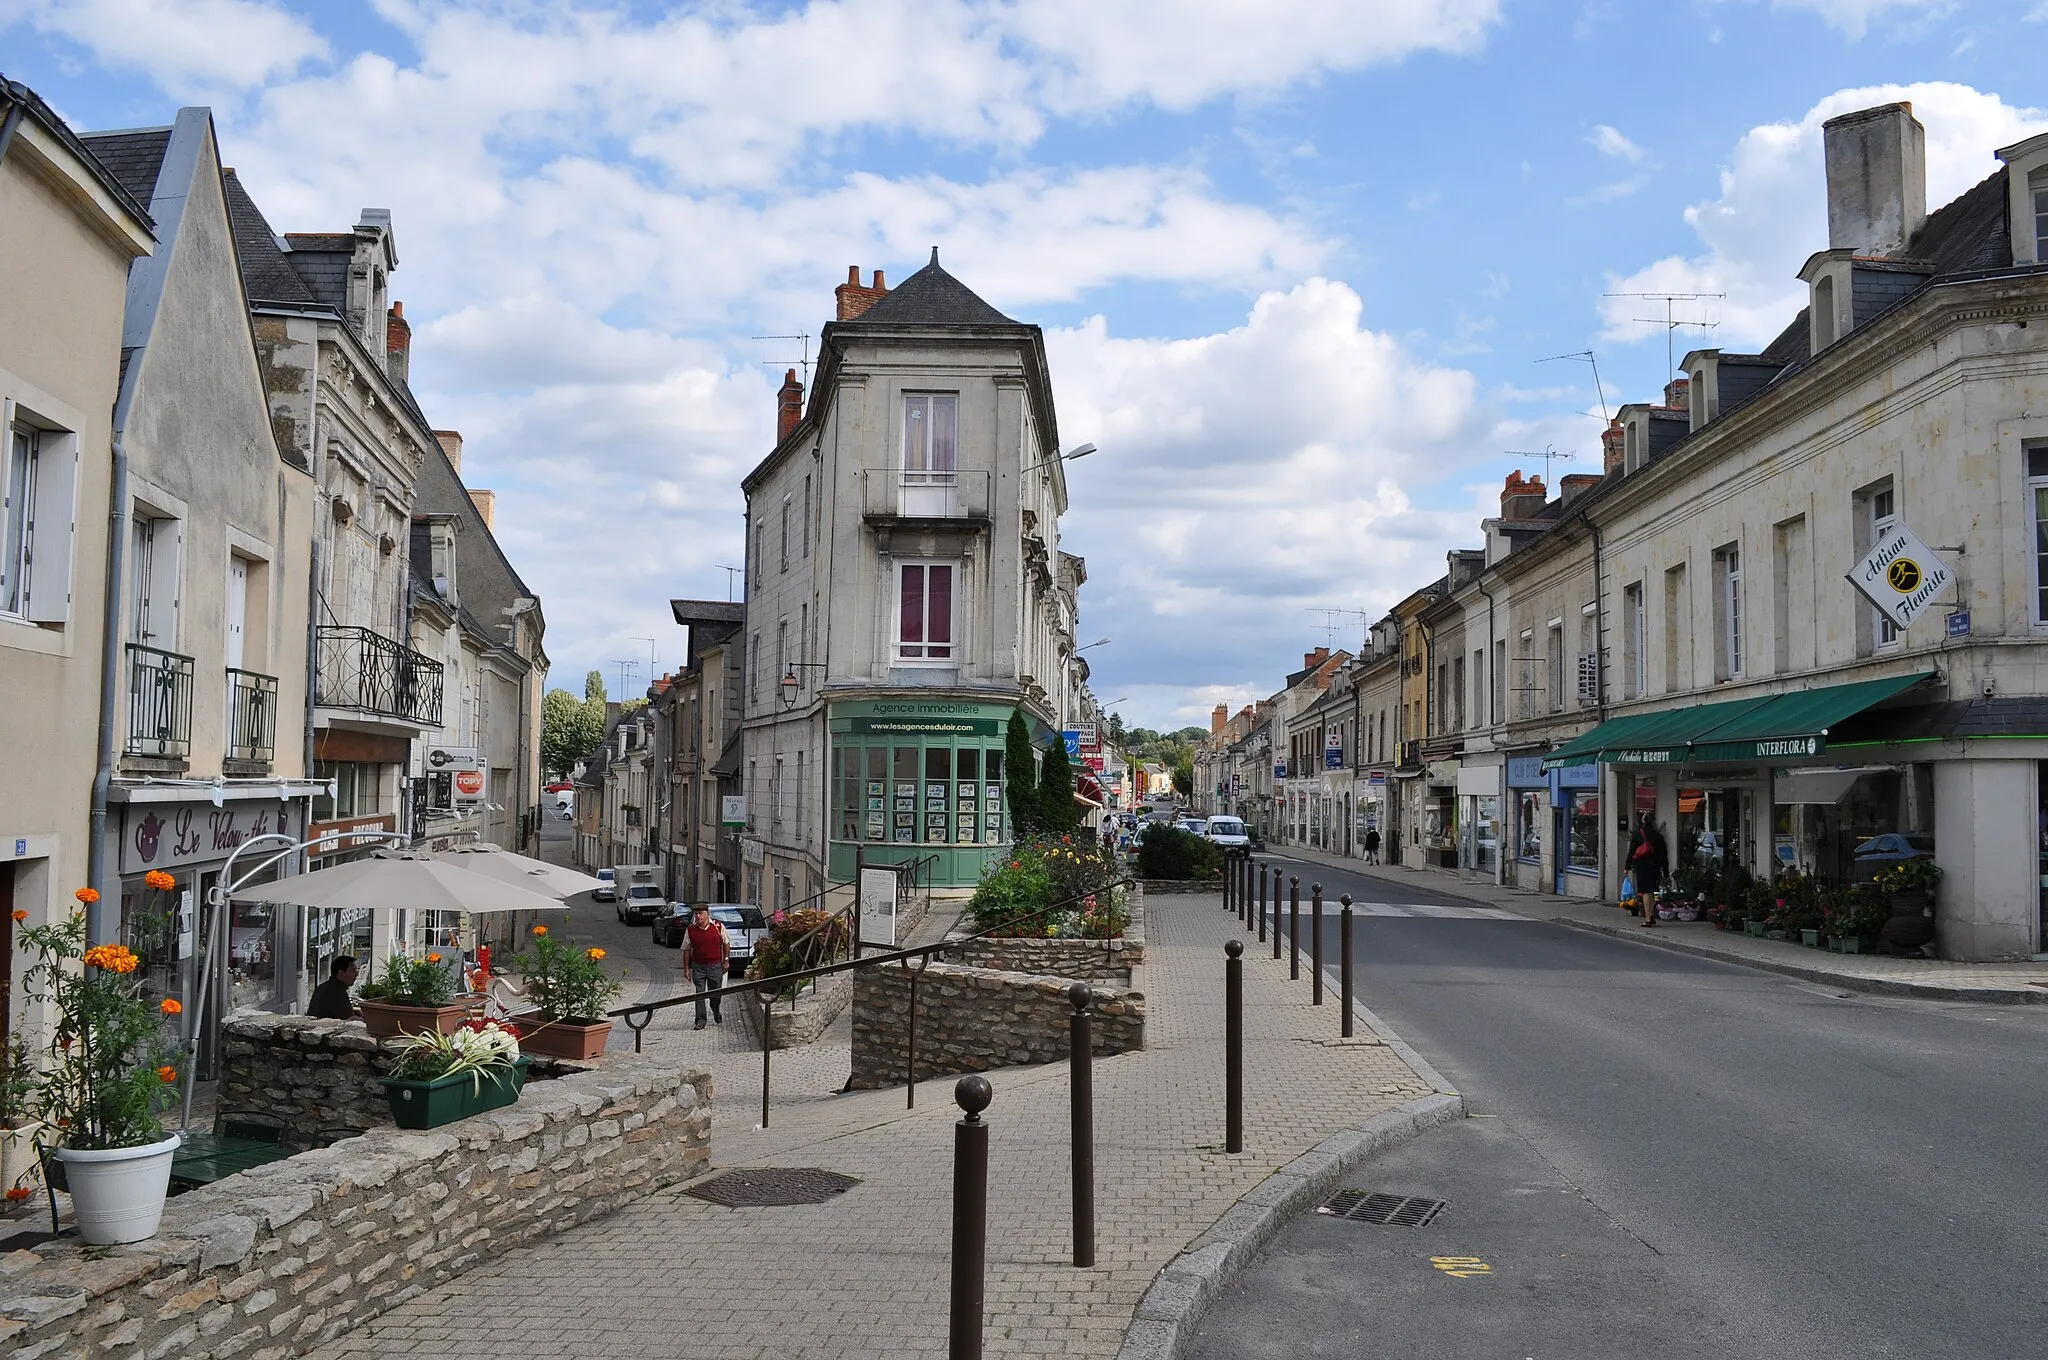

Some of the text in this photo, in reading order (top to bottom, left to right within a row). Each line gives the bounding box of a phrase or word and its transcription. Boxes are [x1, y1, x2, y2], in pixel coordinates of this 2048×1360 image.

[1865, 536, 1907, 582] Artisan
[1895, 569, 1947, 622] Fleuriste
[1578, 657, 1588, 694] POMPES
[1587, 653, 1597, 698] FUNEBRES
[870, 722, 974, 732] www.lesagencesduloir.com
[872, 703, 980, 715] Agence immobilière
[1756, 739, 1807, 756] INTERFLORA
[457, 777, 482, 785] TOPY
[173, 807, 200, 857] Le
